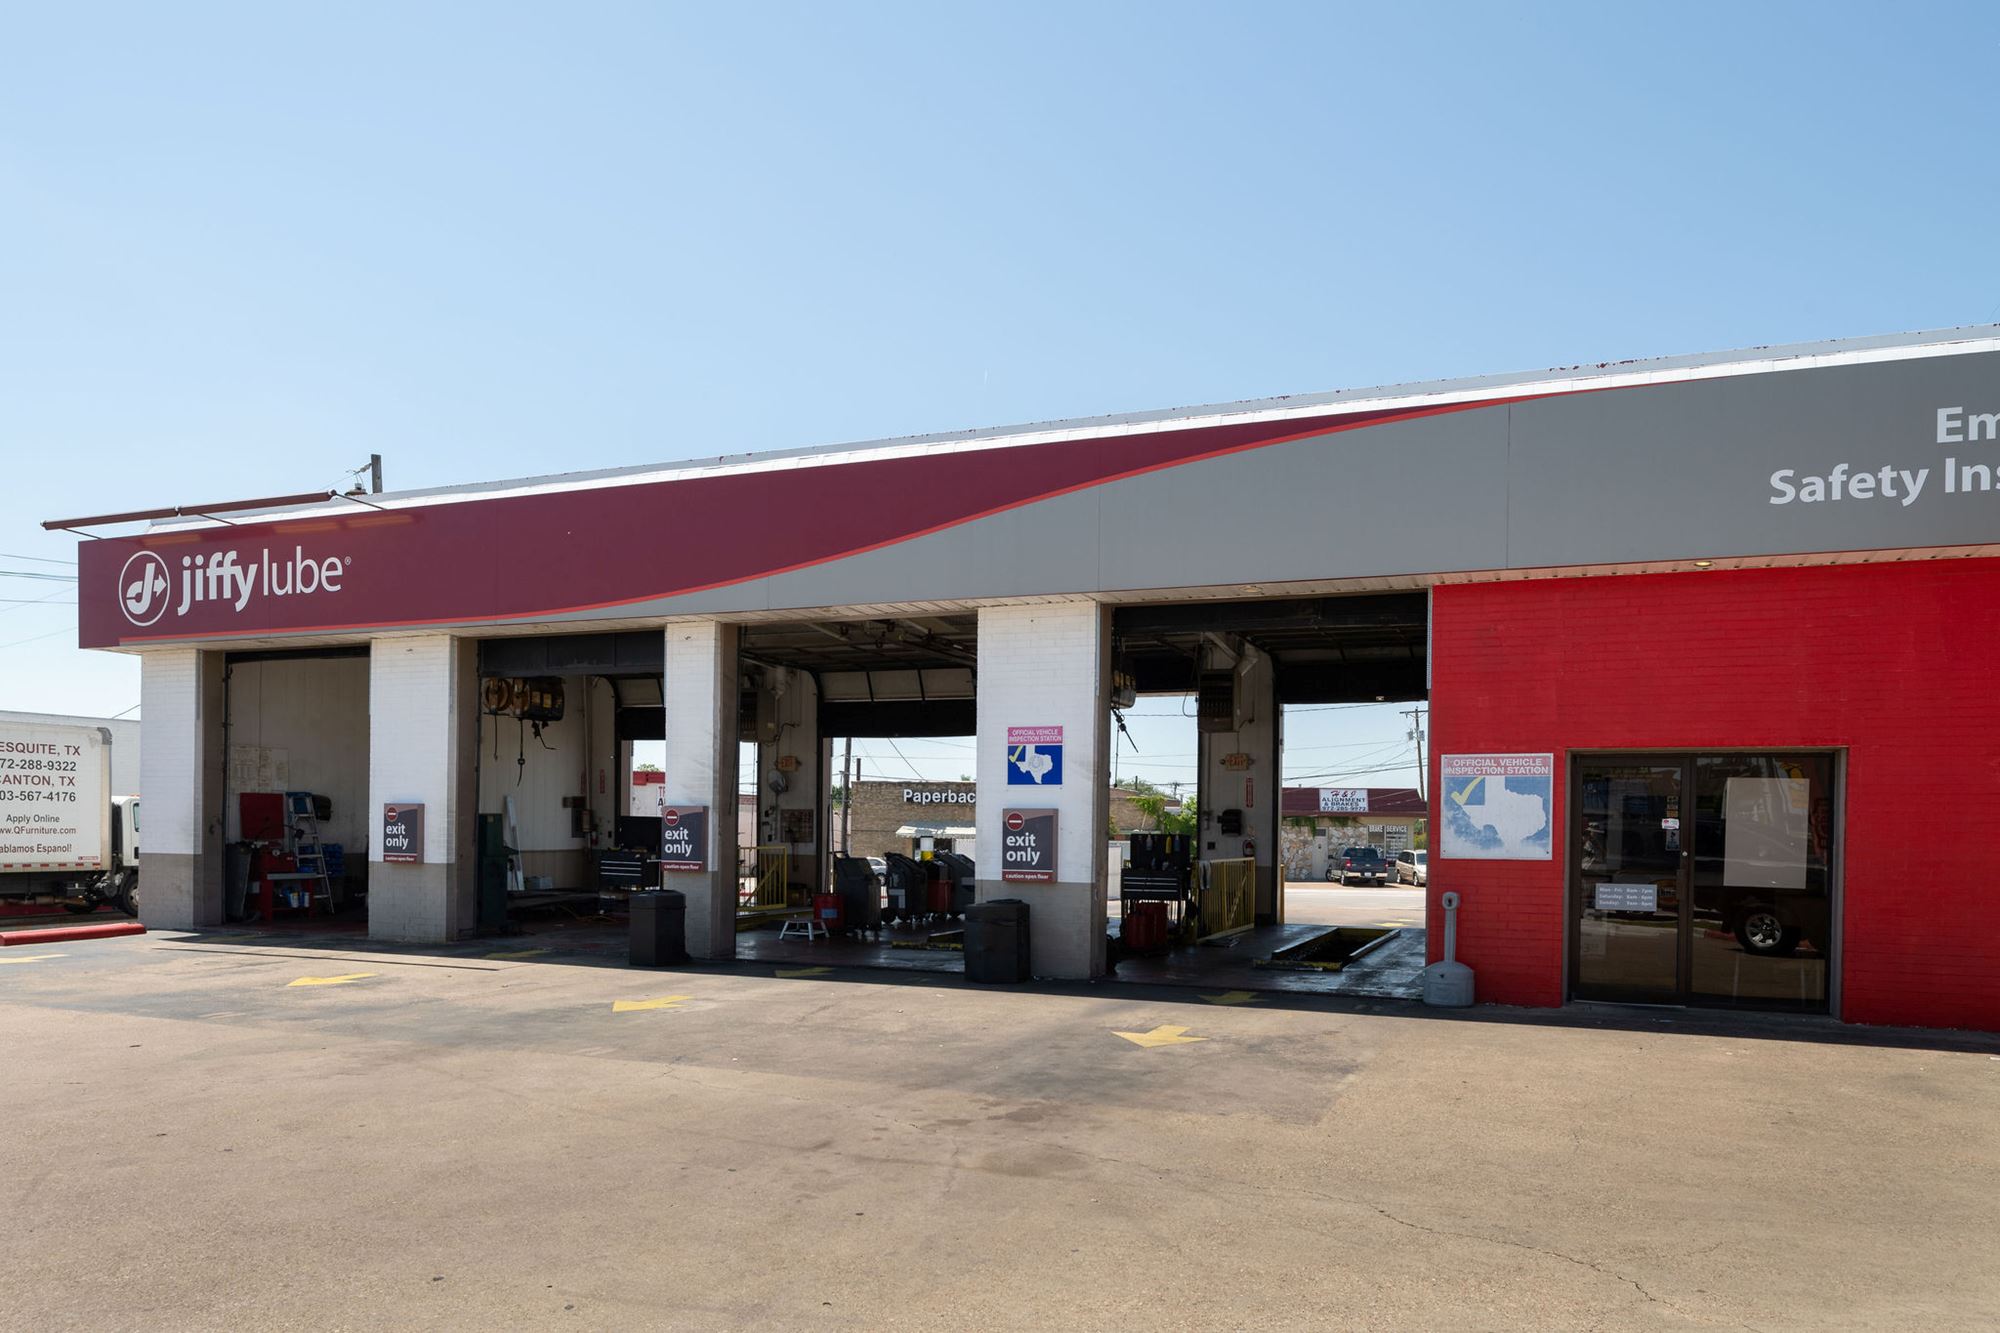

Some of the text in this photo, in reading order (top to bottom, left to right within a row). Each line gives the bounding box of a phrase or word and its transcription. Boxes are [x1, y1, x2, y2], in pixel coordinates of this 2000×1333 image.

[1937, 406, 2000, 443] Em
[1769, 462, 1930, 507] Safety
[177, 550, 258, 616] jiffy
[64, 745, 81, 756] TX
[0, 758, 77, 771] 72-288-9322
[1453, 758, 1542, 767] OFFICIAL VEHICLE
[1447, 766, 1549, 775] NSPECTION STATION
[0, 774, 76, 787] ANTON, TX
[0, 790, 76, 802] 03-567-4176
[903, 788, 976, 805] Paperbac
[6, 814, 60, 825] Apply Online
[386, 822, 406, 834] exit
[664, 826, 689, 840] exit
[386, 835, 409, 850] only
[1006, 832, 1036, 847] exit
[664, 841, 692, 857] only
[1006, 847, 1040, 865] only
